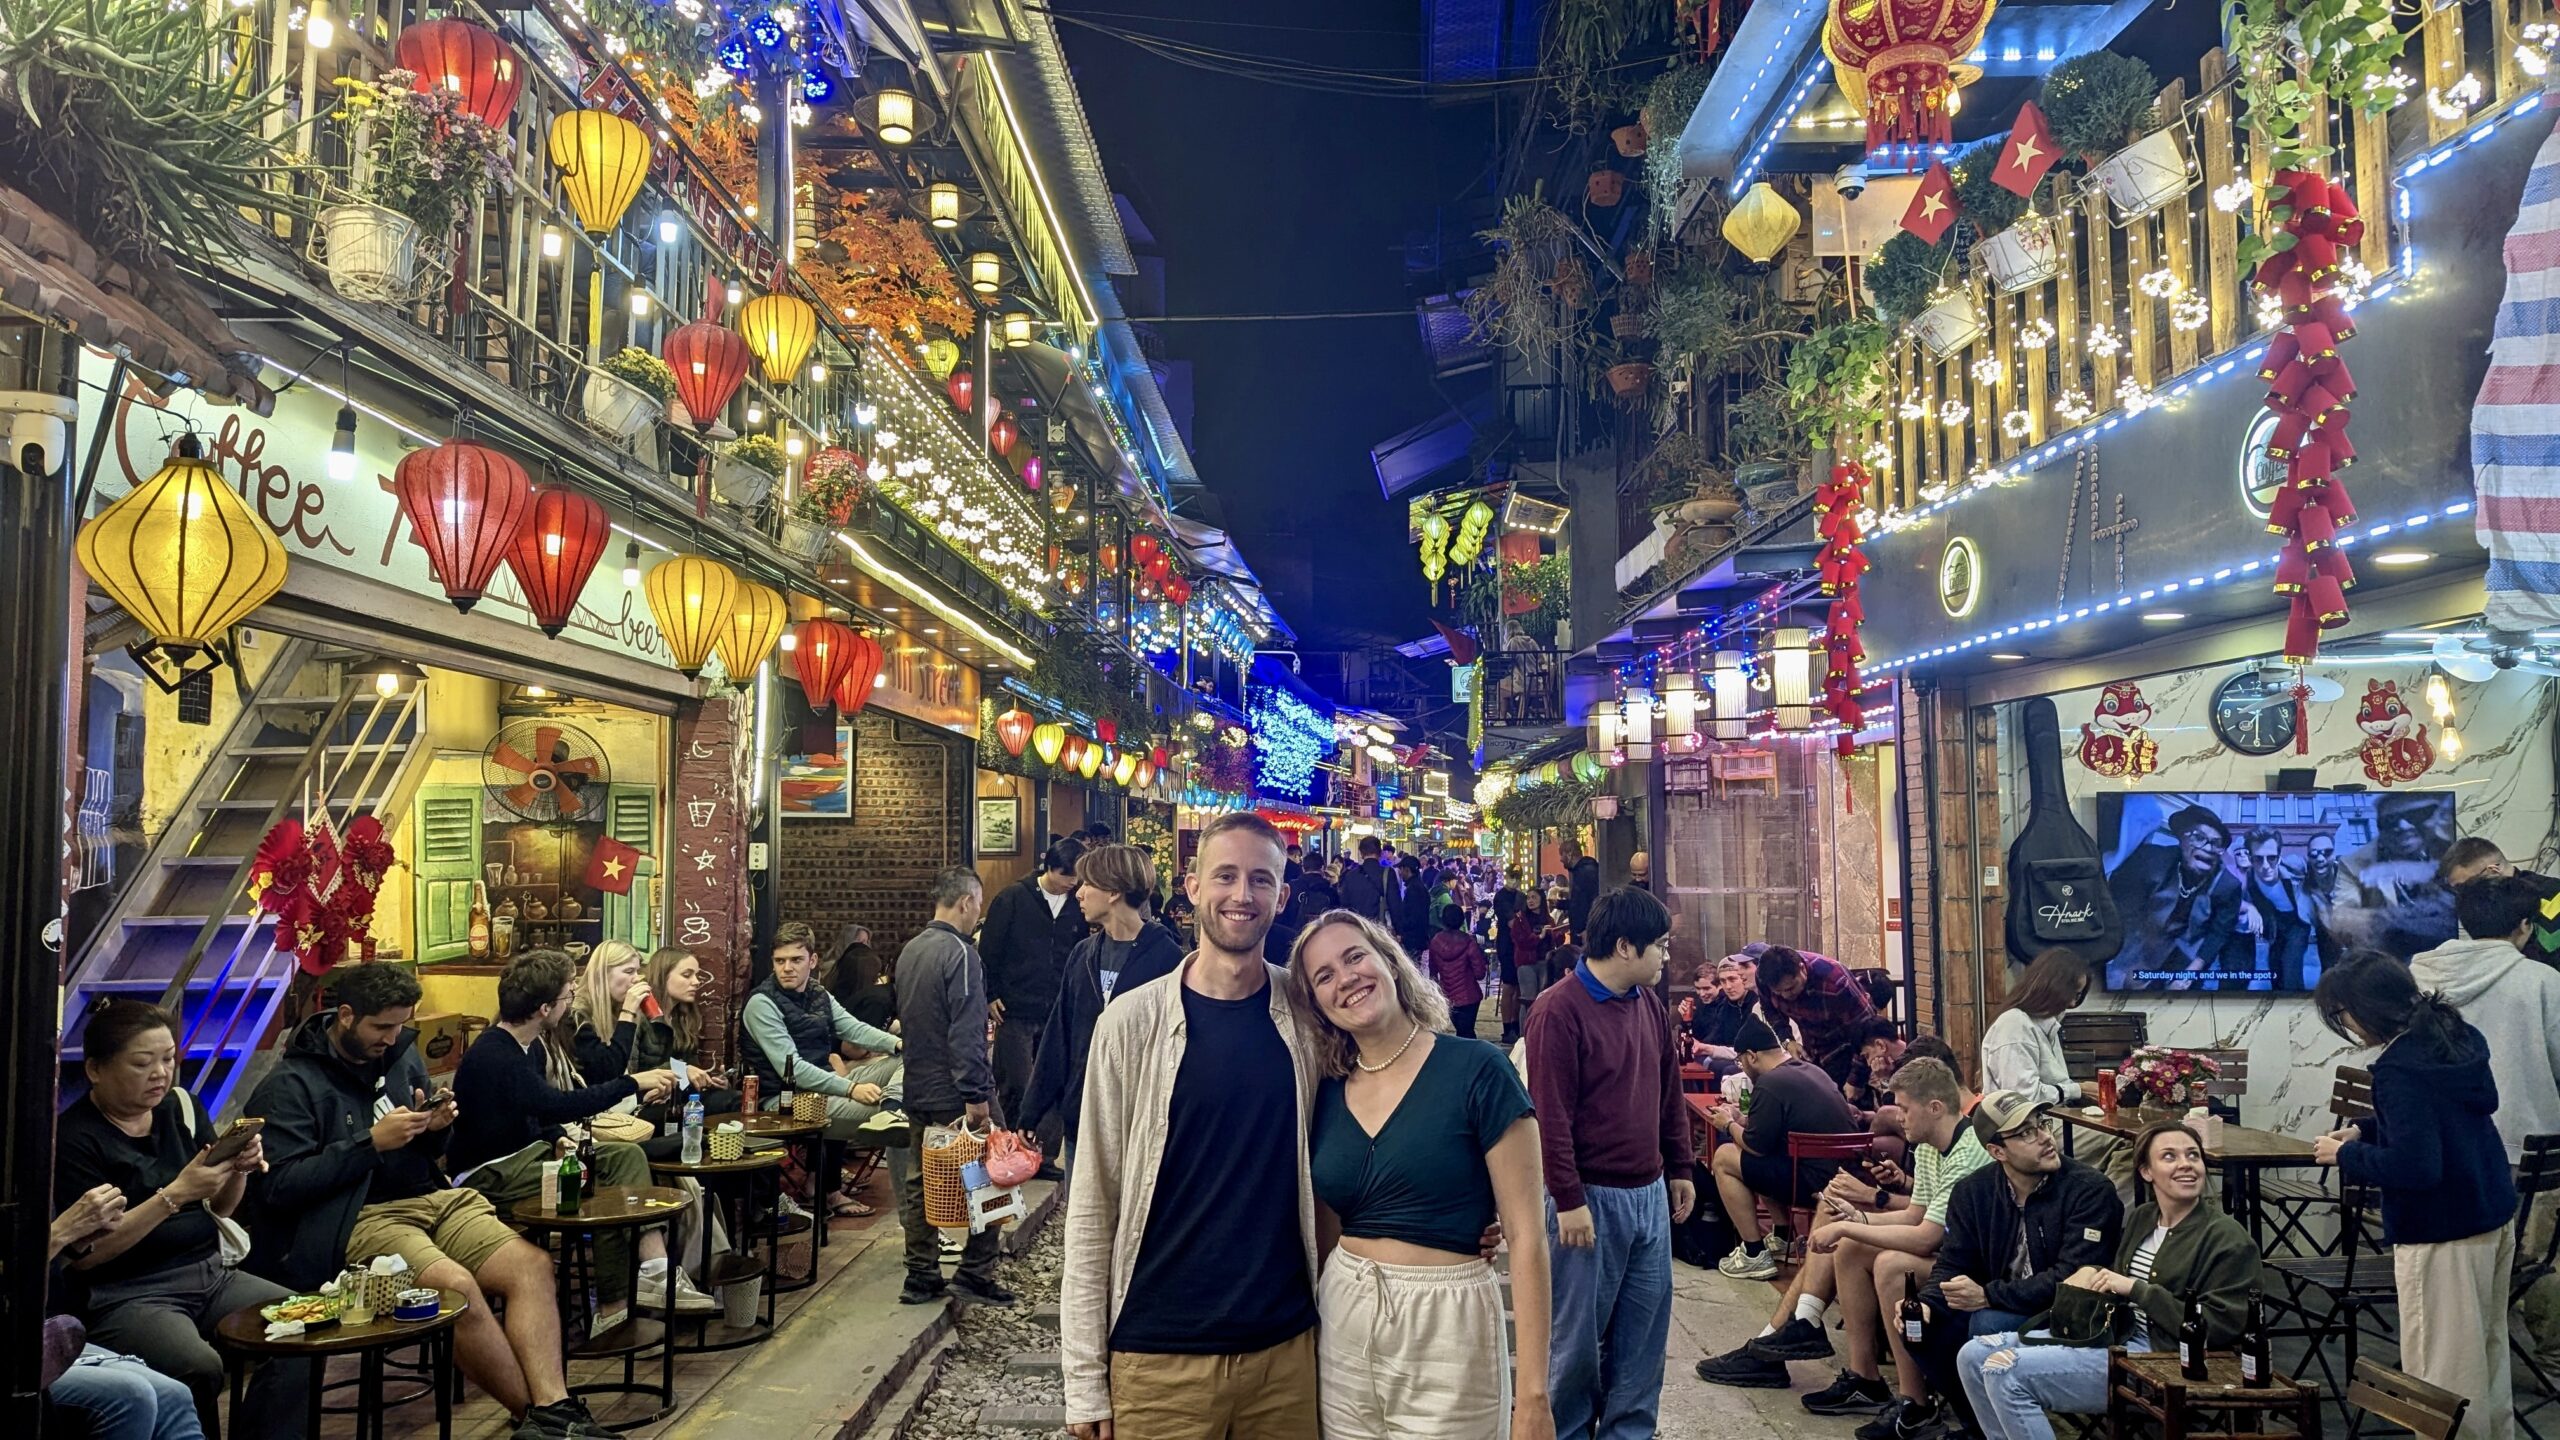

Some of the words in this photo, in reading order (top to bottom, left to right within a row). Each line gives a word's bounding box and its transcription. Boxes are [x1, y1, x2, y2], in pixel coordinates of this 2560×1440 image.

[114, 360, 356, 557] Cffee
[2223, 708, 2232, 718] 9
[2253, 738, 2261, 747] 6
[2138, 971, 2174, 980] Saturday
[2176, 971, 2198, 980] night,
[2200, 971, 2215, 979] and
[2230, 971, 2237, 979] in
[2238, 971, 2251, 979] the
[2253, 972, 2272, 981] spot
